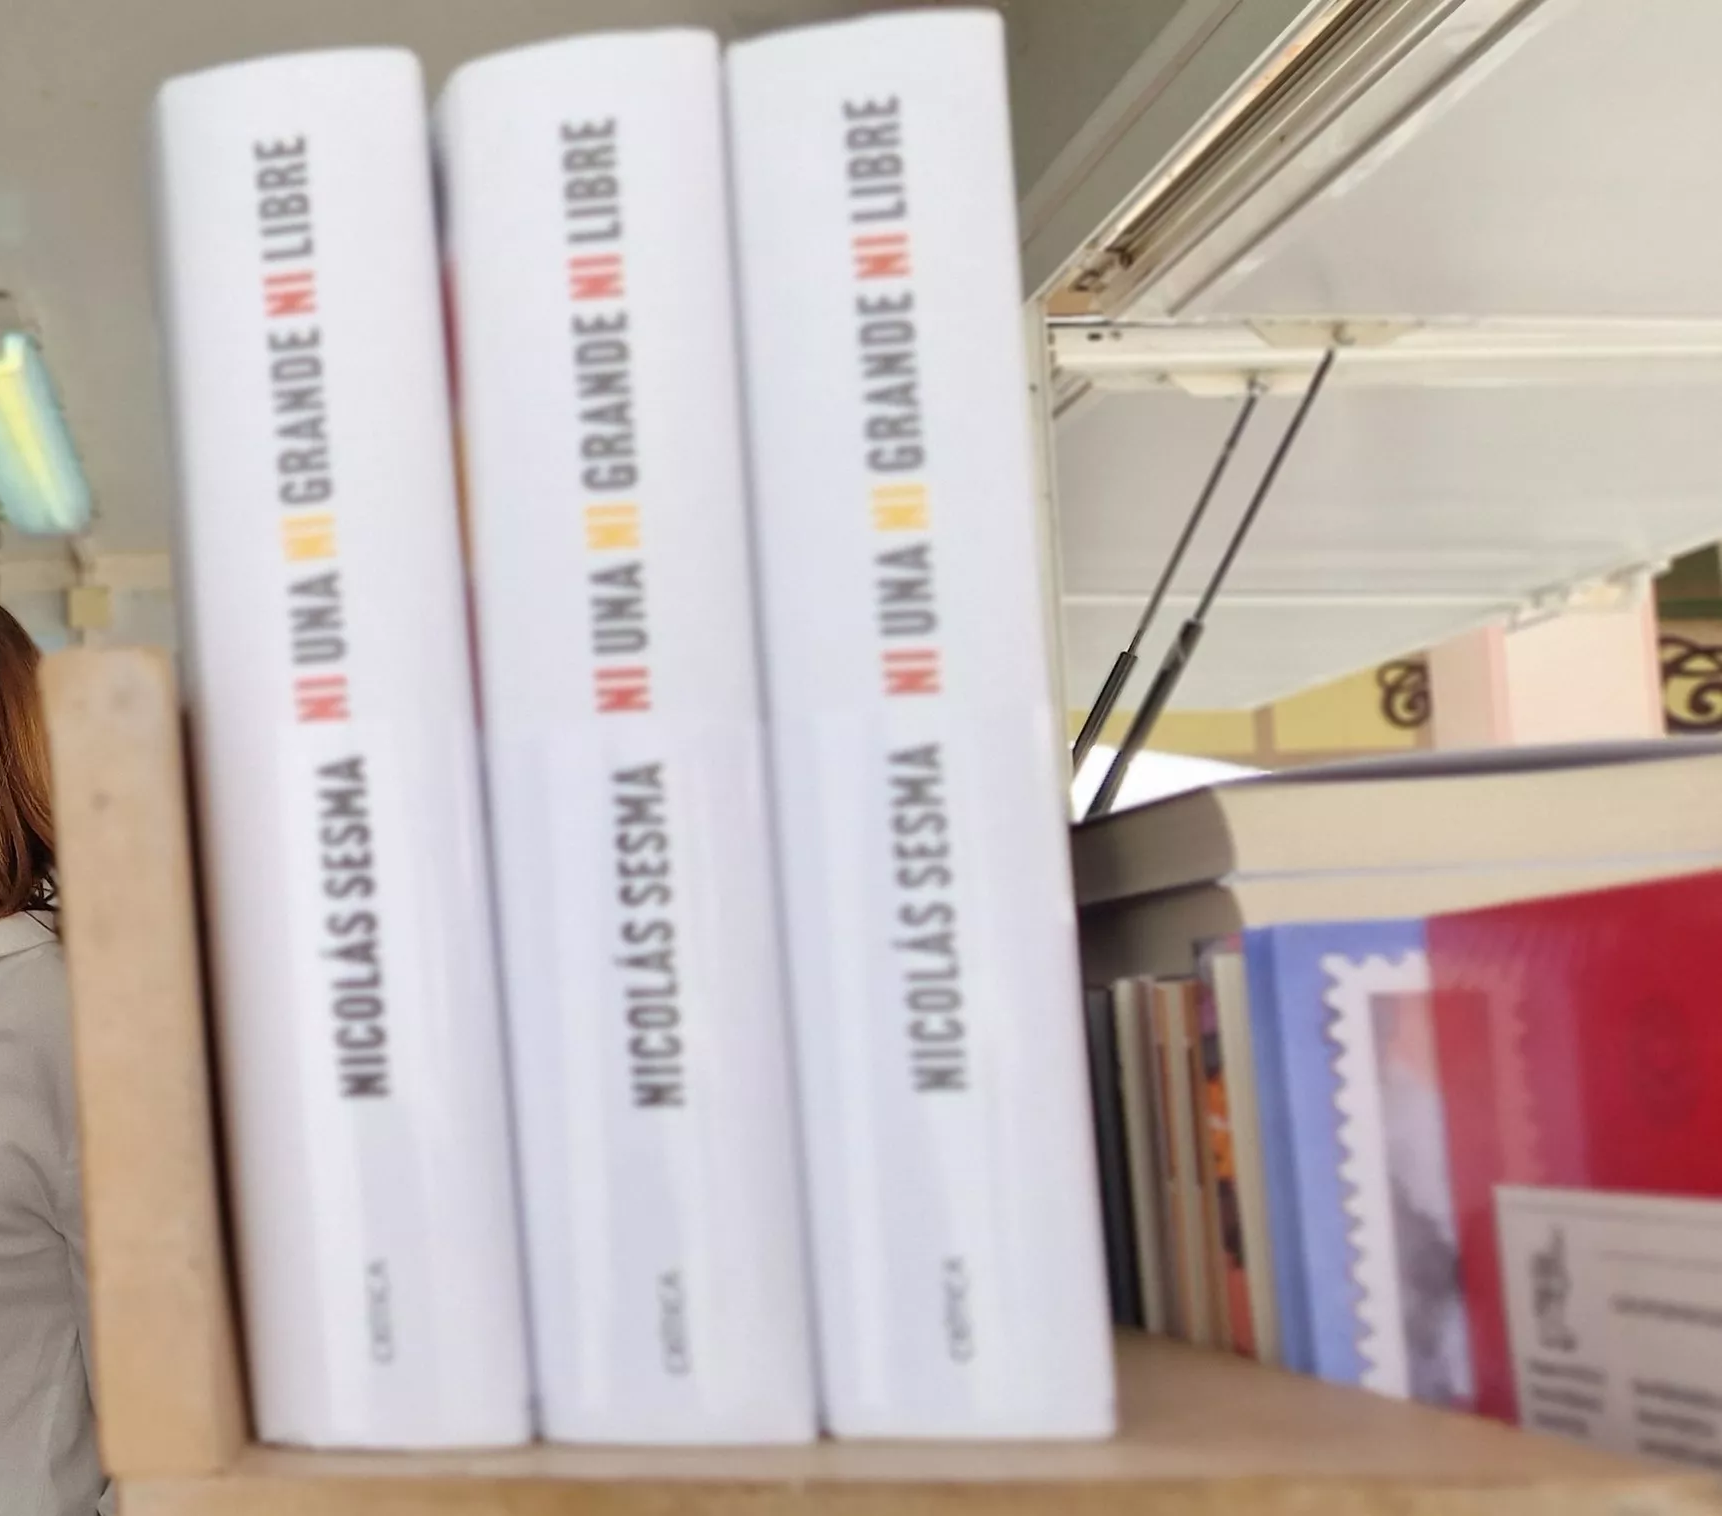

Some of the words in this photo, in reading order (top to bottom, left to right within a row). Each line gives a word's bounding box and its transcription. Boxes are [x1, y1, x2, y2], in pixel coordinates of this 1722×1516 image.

[254, 135, 315, 263] LIBRE
[560, 117, 624, 246] LIBRE
[844, 93, 908, 224] LIBRE
[263, 269, 317, 318] NI
[568, 253, 625, 302] NI
[850, 232, 913, 280] NI
[268, 325, 334, 506] GRANDE
[572, 310, 638, 492] GRANDE
[857, 291, 925, 474] GRANDE
[282, 513, 337, 561] NI
[584, 504, 642, 552] NI
[869, 483, 929, 531] NI
[288, 571, 348, 666] UNA
[587, 560, 649, 656] UNA
[874, 541, 940, 637] UNA
[293, 675, 350, 723] NI
[593, 665, 650, 714] NI
[880, 647, 942, 696] NI
[317, 755, 376, 900] SESMA
[612, 761, 670, 909] SESMA
[888, 741, 952, 889] SESMA
[319, 909, 389, 1098] NICOLÁS
[613, 916, 684, 1109] NICOLÁS
[892, 901, 968, 1094] NICOLÁS
